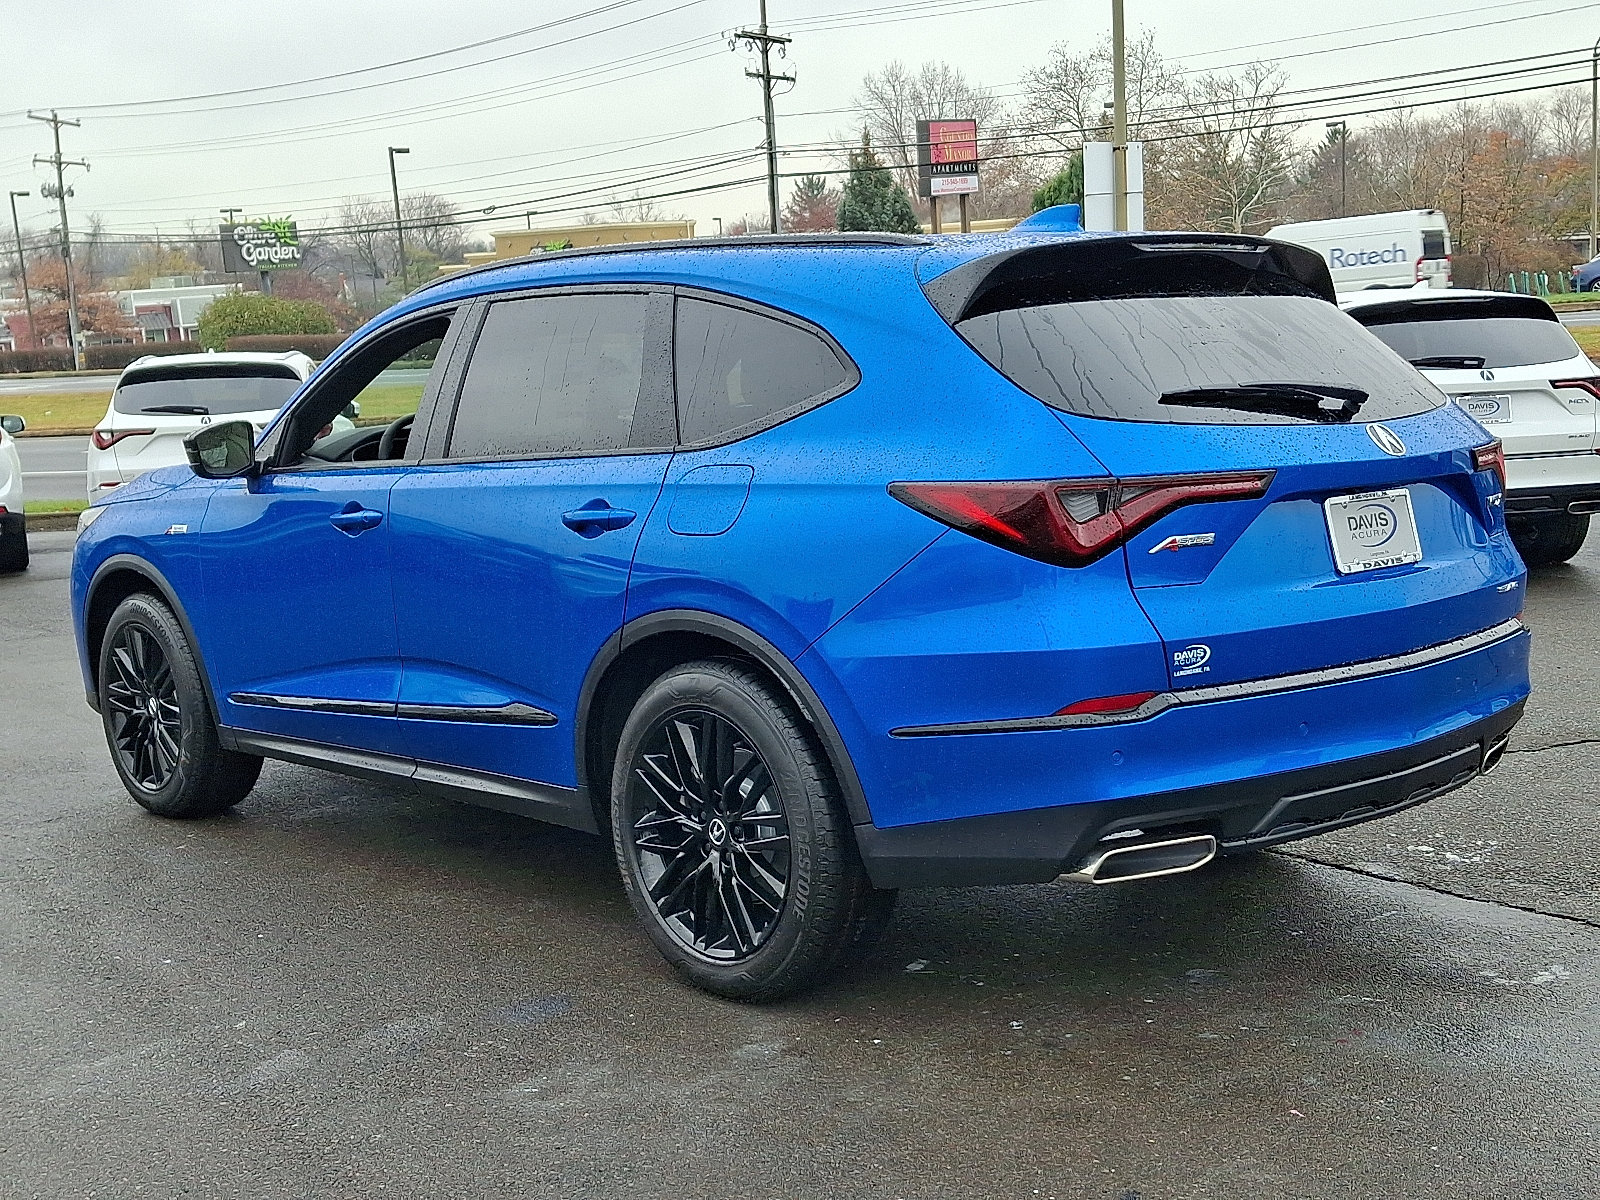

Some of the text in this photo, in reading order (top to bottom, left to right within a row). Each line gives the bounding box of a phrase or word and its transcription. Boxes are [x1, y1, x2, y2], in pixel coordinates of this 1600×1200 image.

[932, 163, 976, 174] APARTMENTS
[233, 226, 277, 245] Olive
[241, 243, 300, 267] Garden
[1329, 242, 1408, 269] Rotech
[1468, 402, 1495, 411] DAVIS
[1346, 511, 1389, 532] DAVIS
[1351, 528, 1388, 541] ACURA
[1362, 556, 1404, 570] DAVIS
[1174, 649, 1205, 661] DAVIS
[1174, 657, 1202, 666] ACURA
